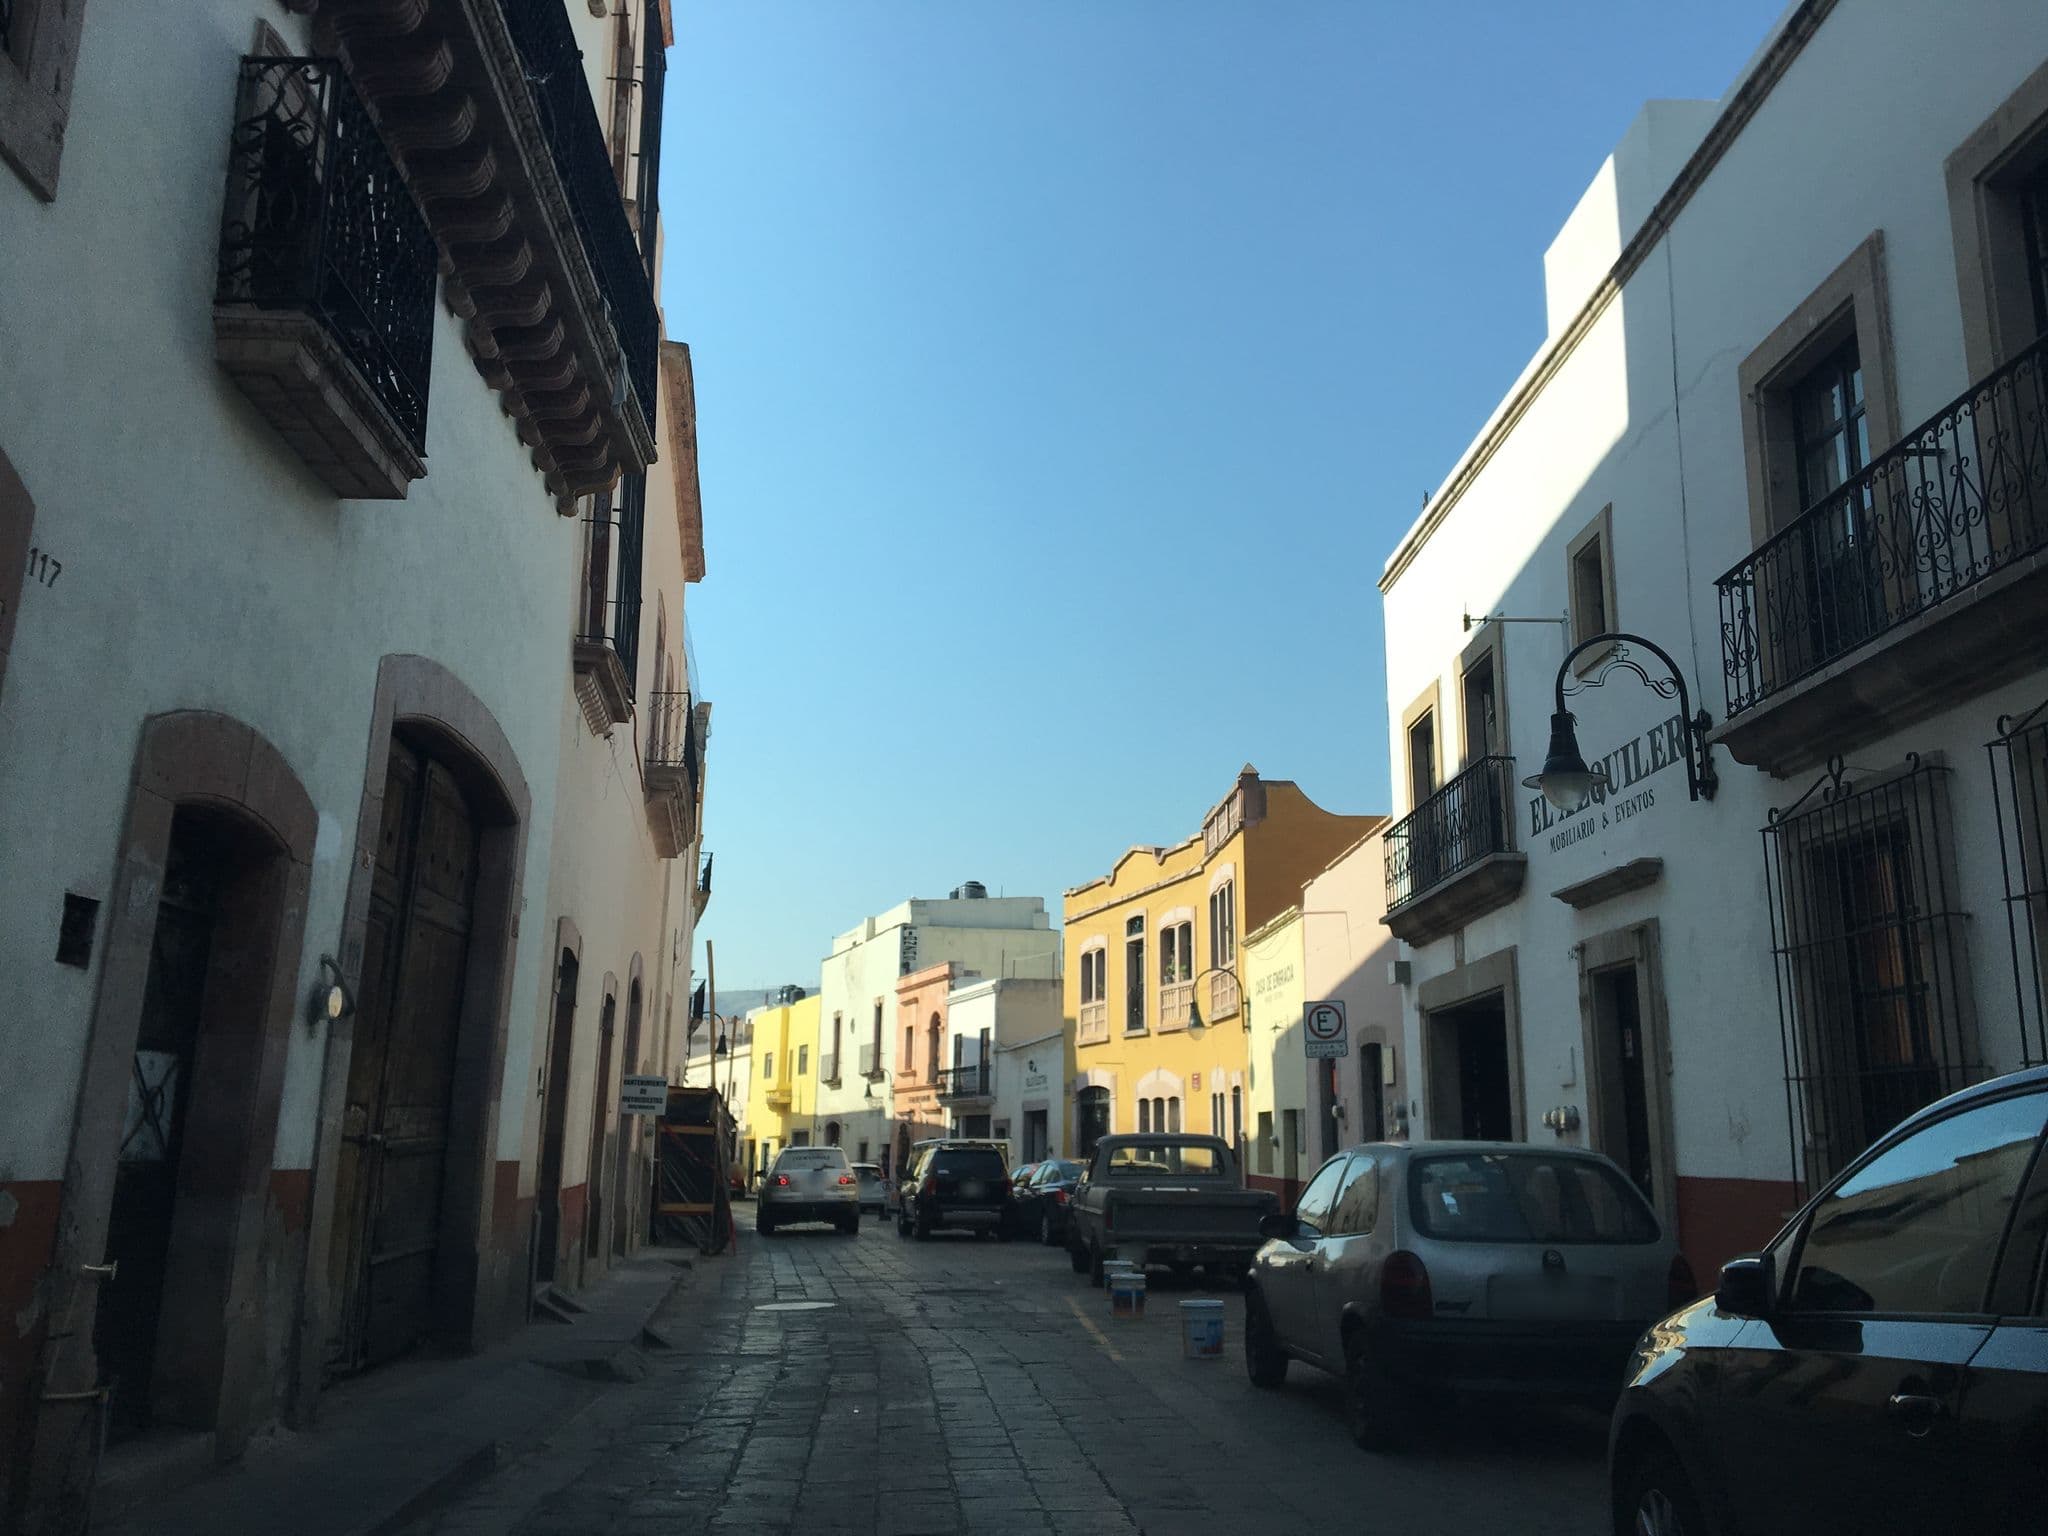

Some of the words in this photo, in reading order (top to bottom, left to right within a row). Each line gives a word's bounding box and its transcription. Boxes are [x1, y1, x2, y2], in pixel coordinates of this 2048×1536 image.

[29, 548, 62, 588] 117
[1529, 795, 1554, 837] EL
[1558, 714, 1687, 822] QUILER
[1550, 817, 1595, 853] MOBILIARIO
[1602, 811, 1610, 830] &
[1615, 788, 1655, 824] EVENTOS
[1316, 1010, 1333, 1032] E
